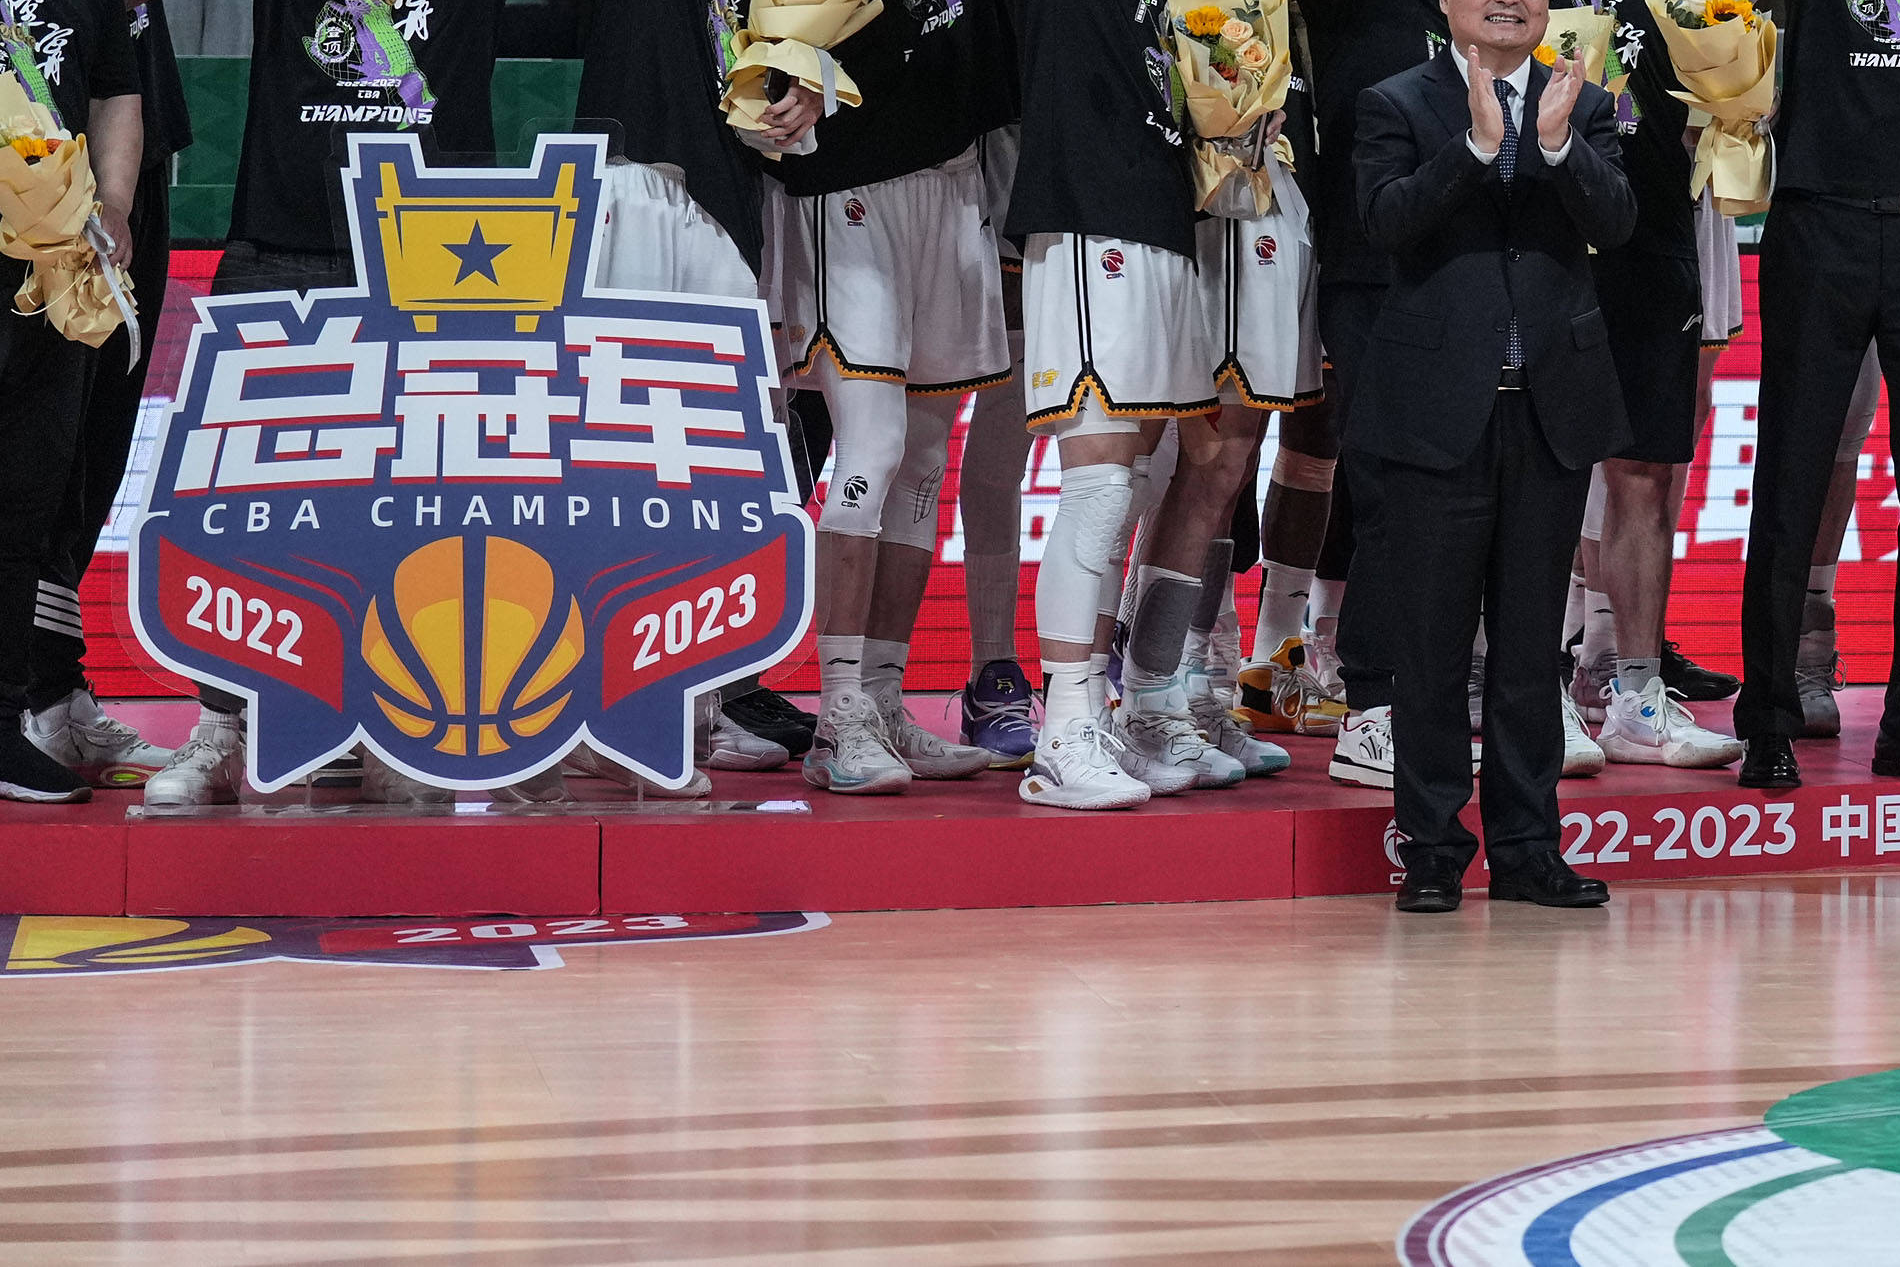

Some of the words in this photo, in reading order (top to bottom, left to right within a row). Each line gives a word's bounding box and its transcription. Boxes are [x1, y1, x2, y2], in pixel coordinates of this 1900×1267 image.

[301, 105, 433, 125] CHAMPIONS
[203, 498, 321, 535] CBA
[370, 495, 765, 533] CHAMPIONS
[186, 575, 303, 667] 2022
[632, 573, 758, 672] 2023
[1561, 802, 1797, 865] 22-2023
[396, 915, 689, 944] 2023
